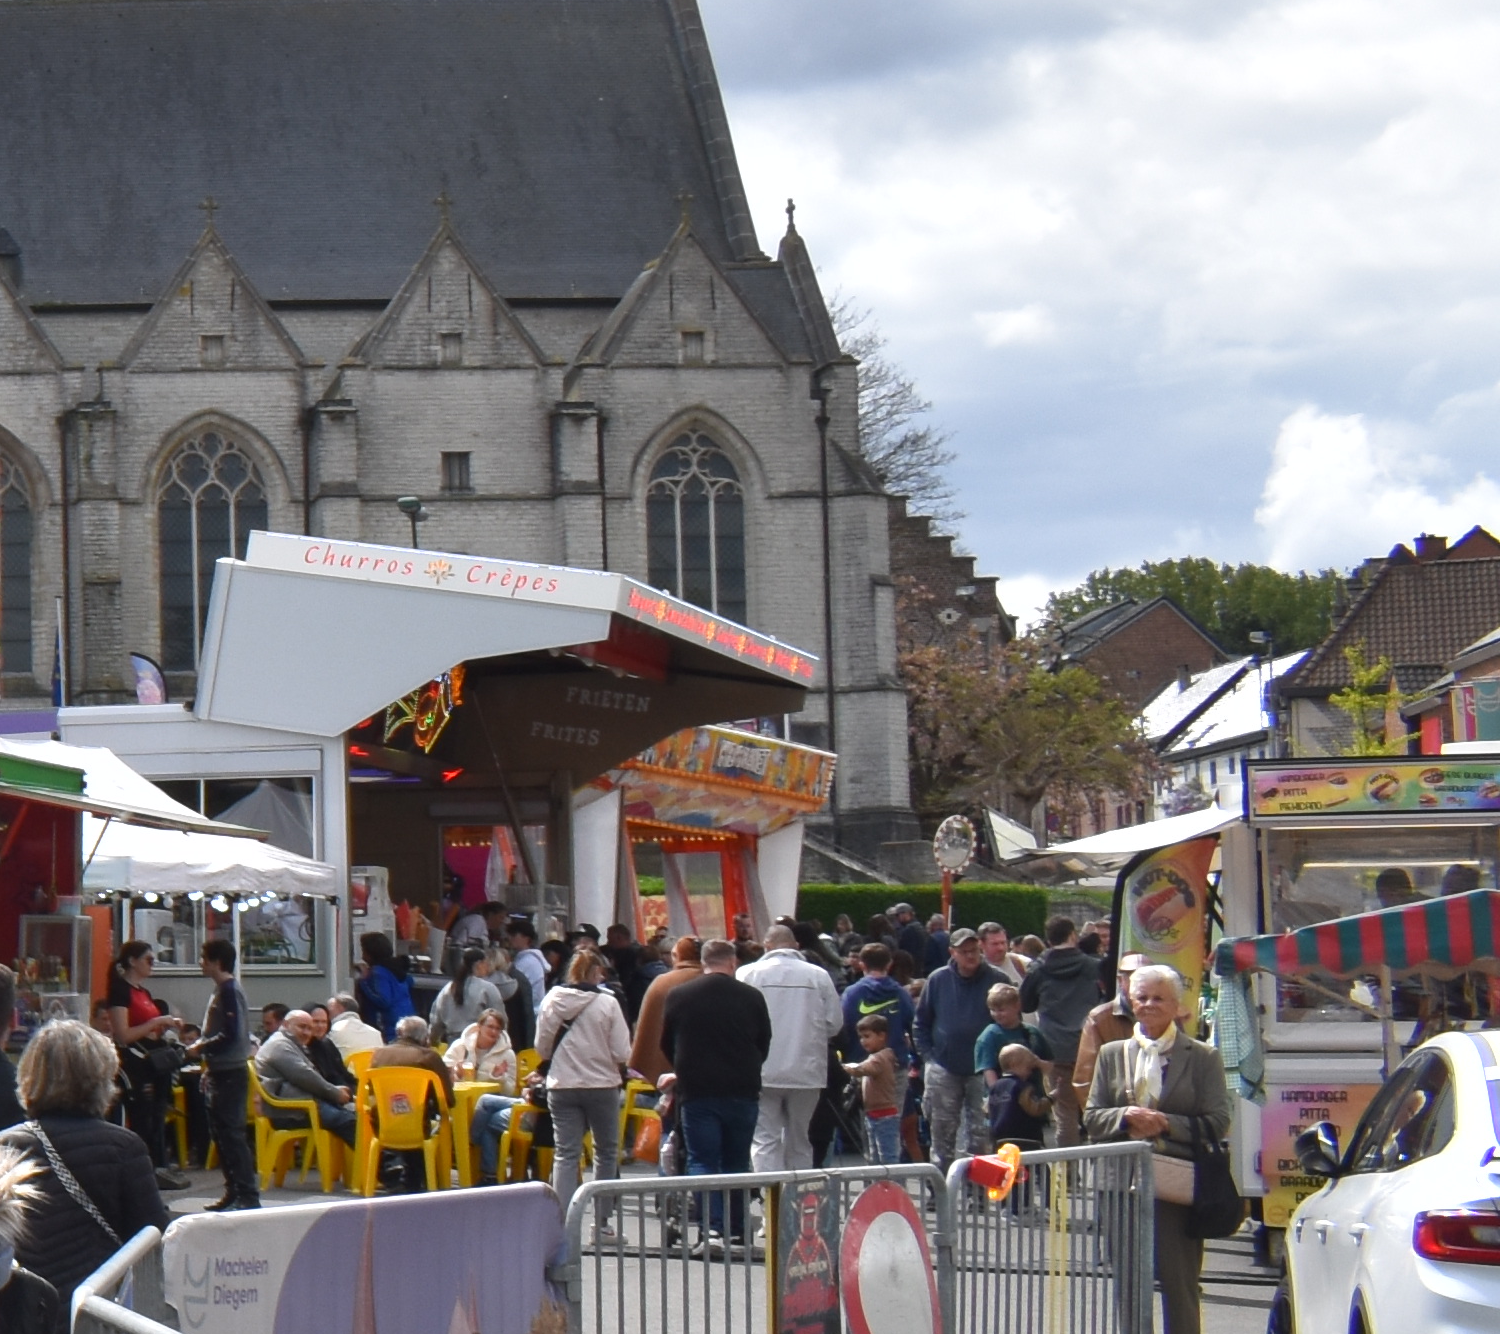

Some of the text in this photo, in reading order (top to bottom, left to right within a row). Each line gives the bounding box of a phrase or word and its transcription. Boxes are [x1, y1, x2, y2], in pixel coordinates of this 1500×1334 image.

[304, 544, 414, 575] Churros
[566, 687, 650, 713] FRIETEN
[530, 721, 599, 746] FRITES
[1300, 1107, 1330, 1120] PITTA
[214, 1256, 268, 1277] Machelen
[213, 1284, 258, 1311] Diegem
